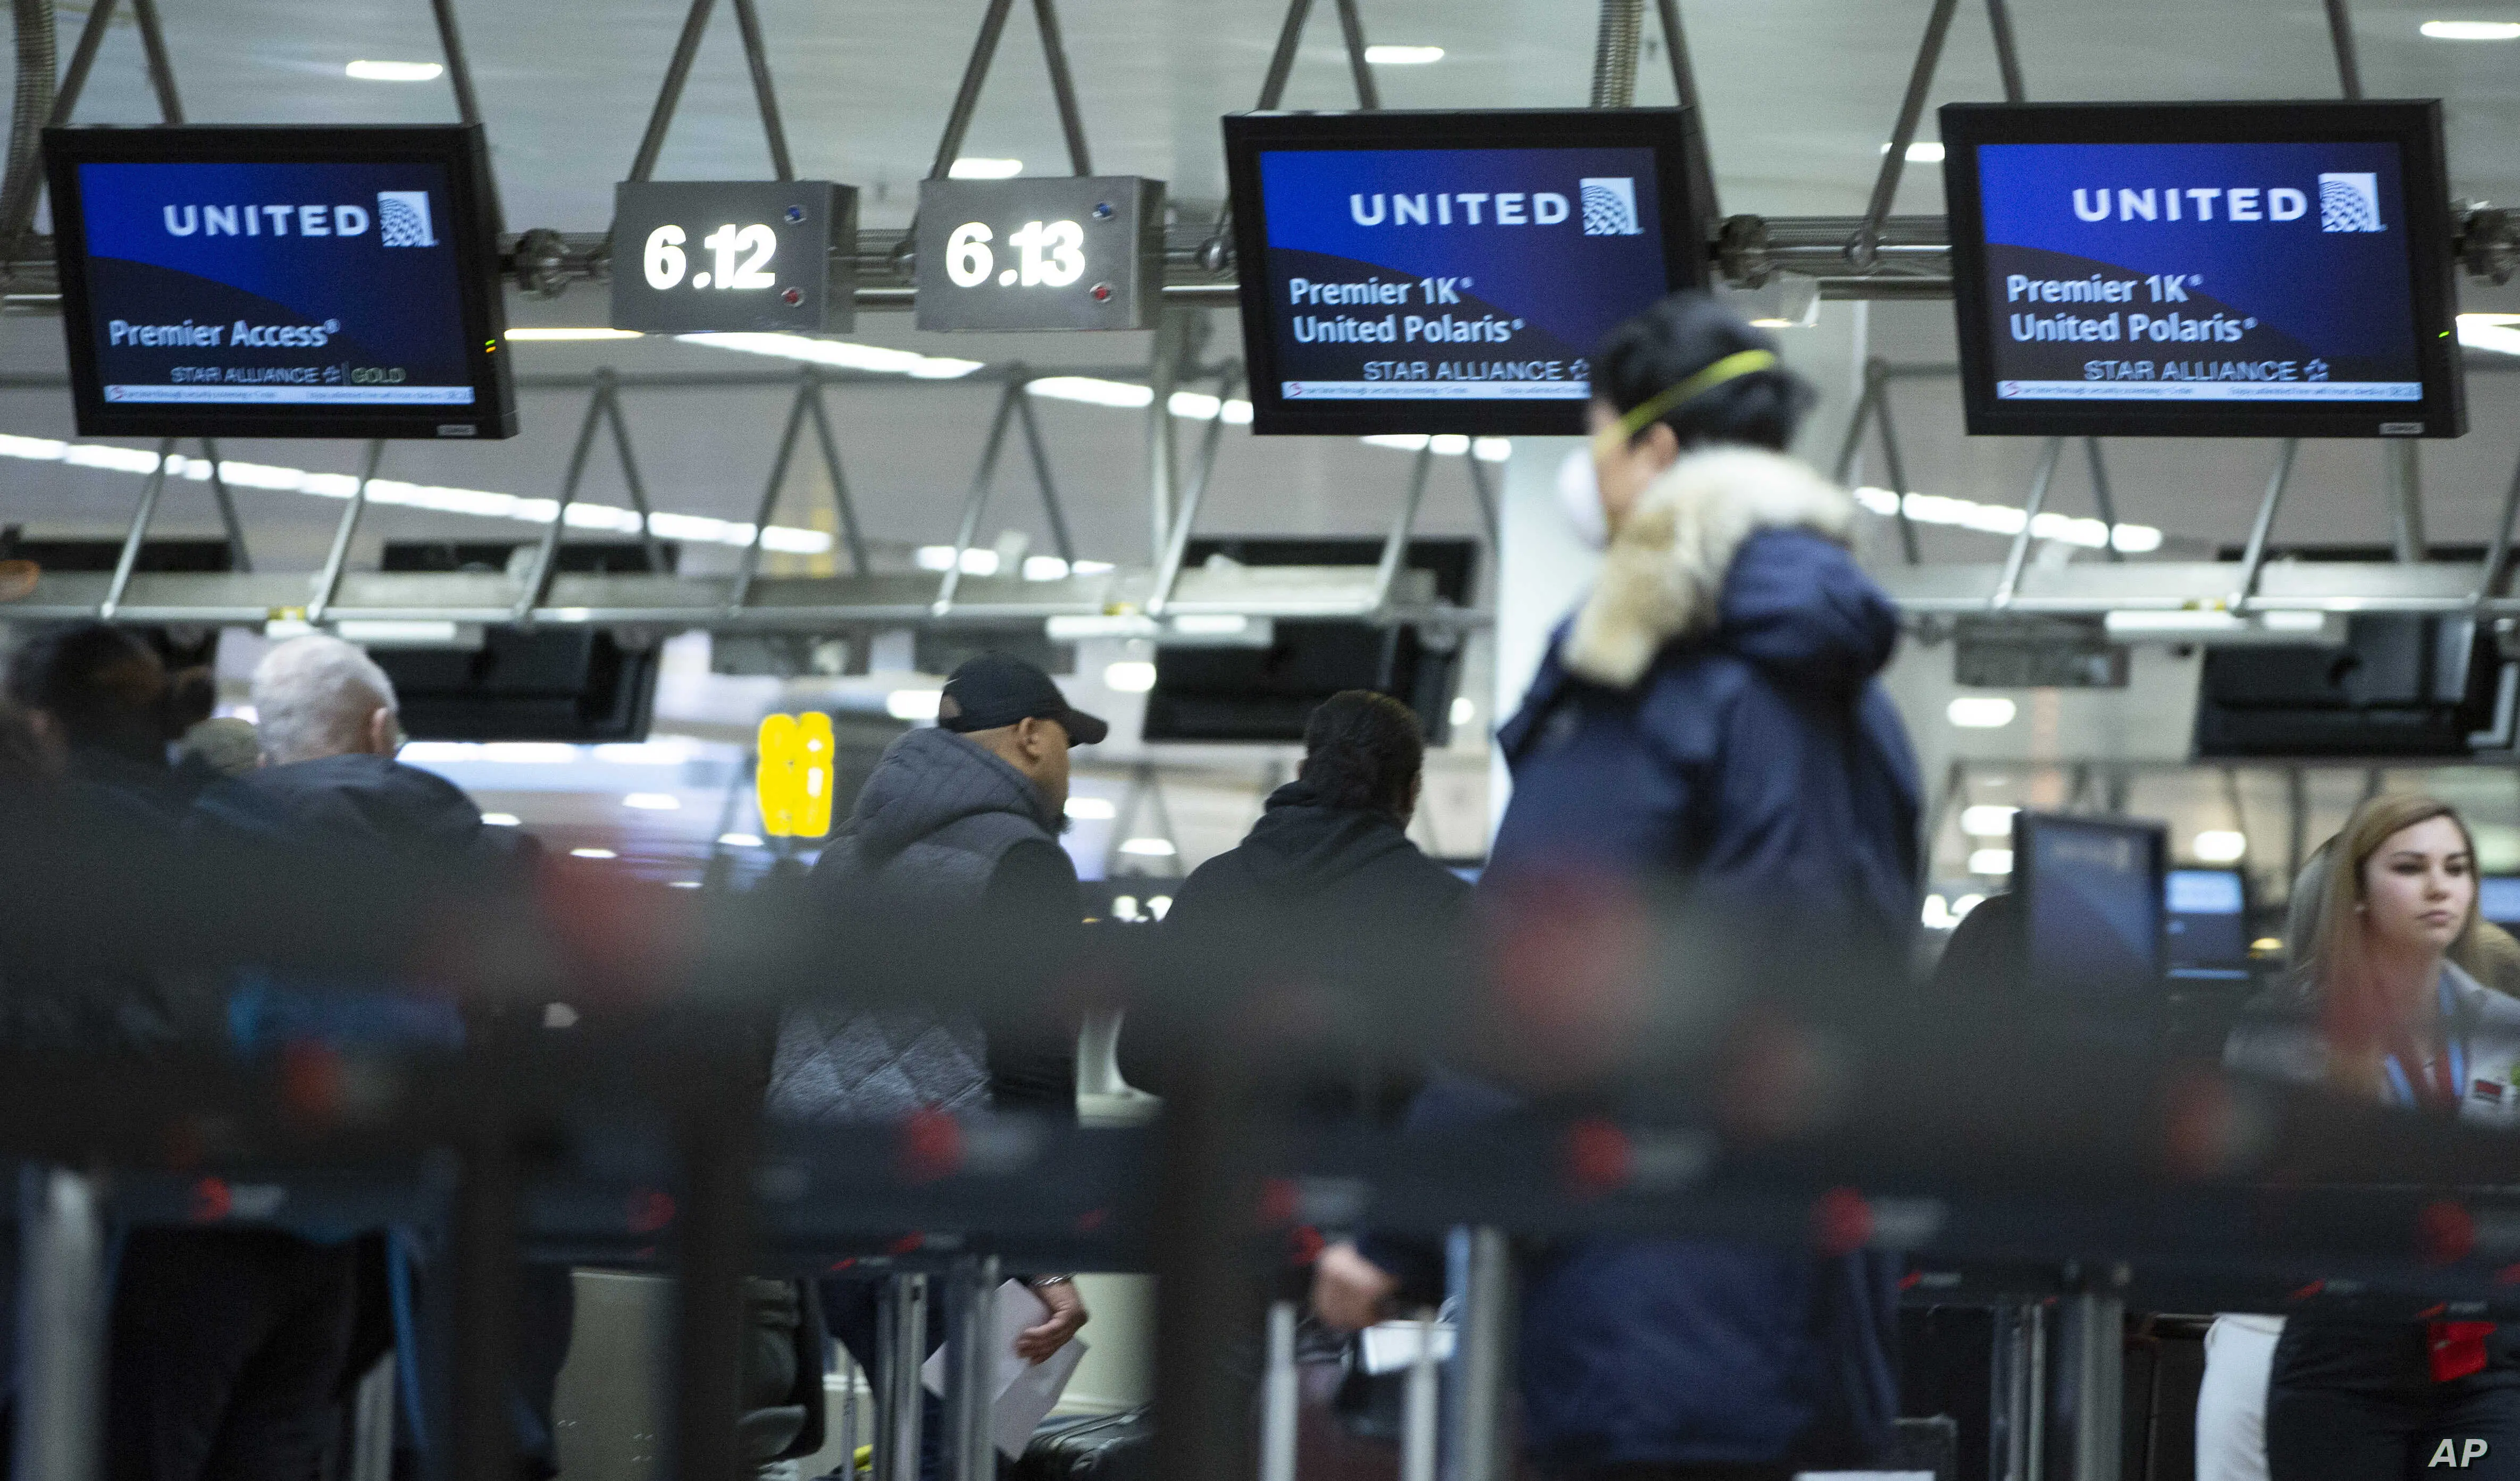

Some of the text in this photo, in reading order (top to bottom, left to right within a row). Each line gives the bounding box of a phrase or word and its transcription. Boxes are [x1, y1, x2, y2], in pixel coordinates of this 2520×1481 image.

[1351, 193, 1569, 226] UNITED
[2072, 188, 2307, 222] UNITED
[163, 205, 369, 237] UNITED
[643, 224, 777, 290] 6.12
[945, 220, 1086, 288] 6.13
[1290, 277, 1412, 305] Premier
[2007, 274, 2138, 302] Premier
[109, 319, 223, 346] Premier
[1293, 314, 1397, 343] United
[2011, 312, 2120, 341] United
[171, 366, 406, 384] STAR ALLIANCE GOLD
[1363, 361, 1563, 381] STAR ALLIANCE
[2084, 360, 2298, 381] STAR ALLIANCE
